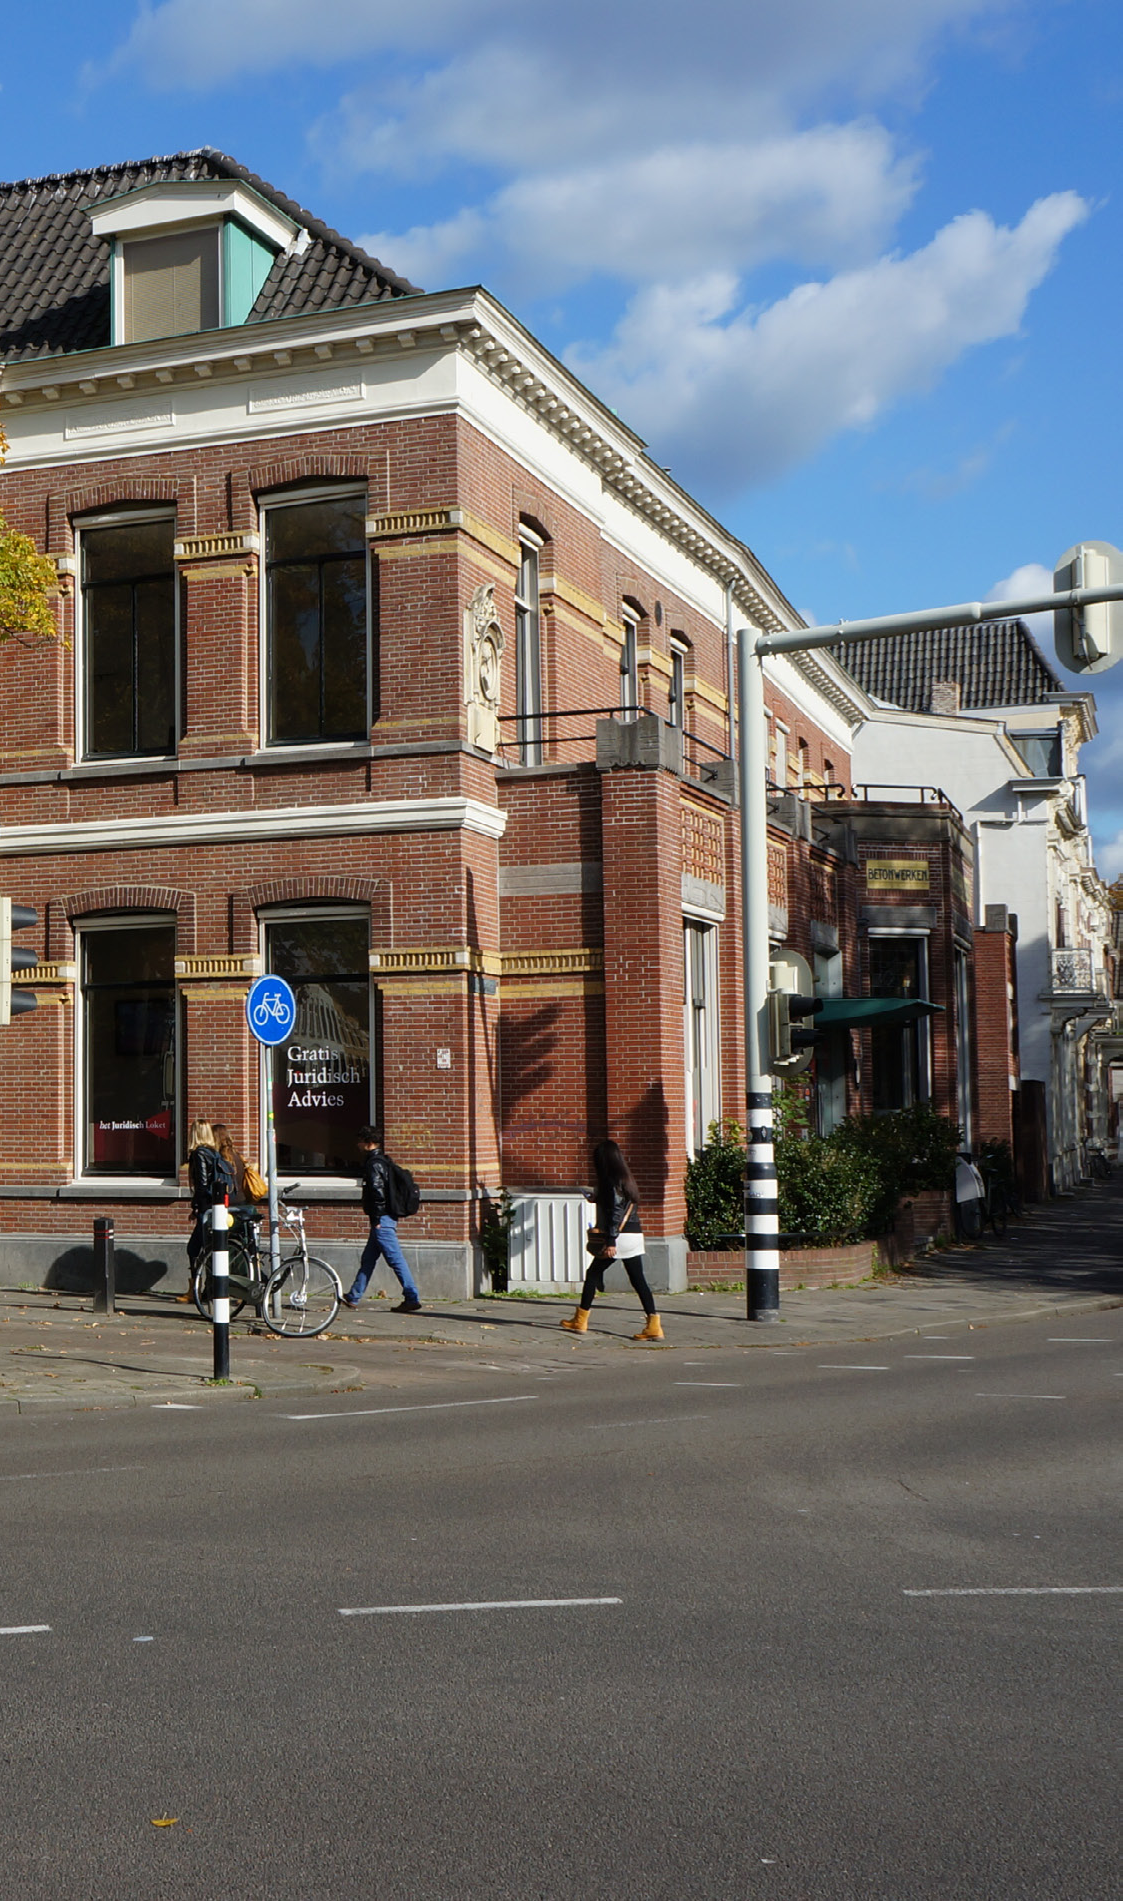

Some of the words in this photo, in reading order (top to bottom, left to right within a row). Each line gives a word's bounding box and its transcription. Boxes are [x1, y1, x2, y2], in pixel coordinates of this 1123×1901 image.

[287, 1045, 339, 1062] Gratis
[287, 1066, 361, 1088] Juridisch
[287, 1089, 344, 1108] Advies
[99, 1120, 111, 1130] het
[111, 1120, 145, 1131] Juridisch
[145, 1120, 166, 1129] Loket
